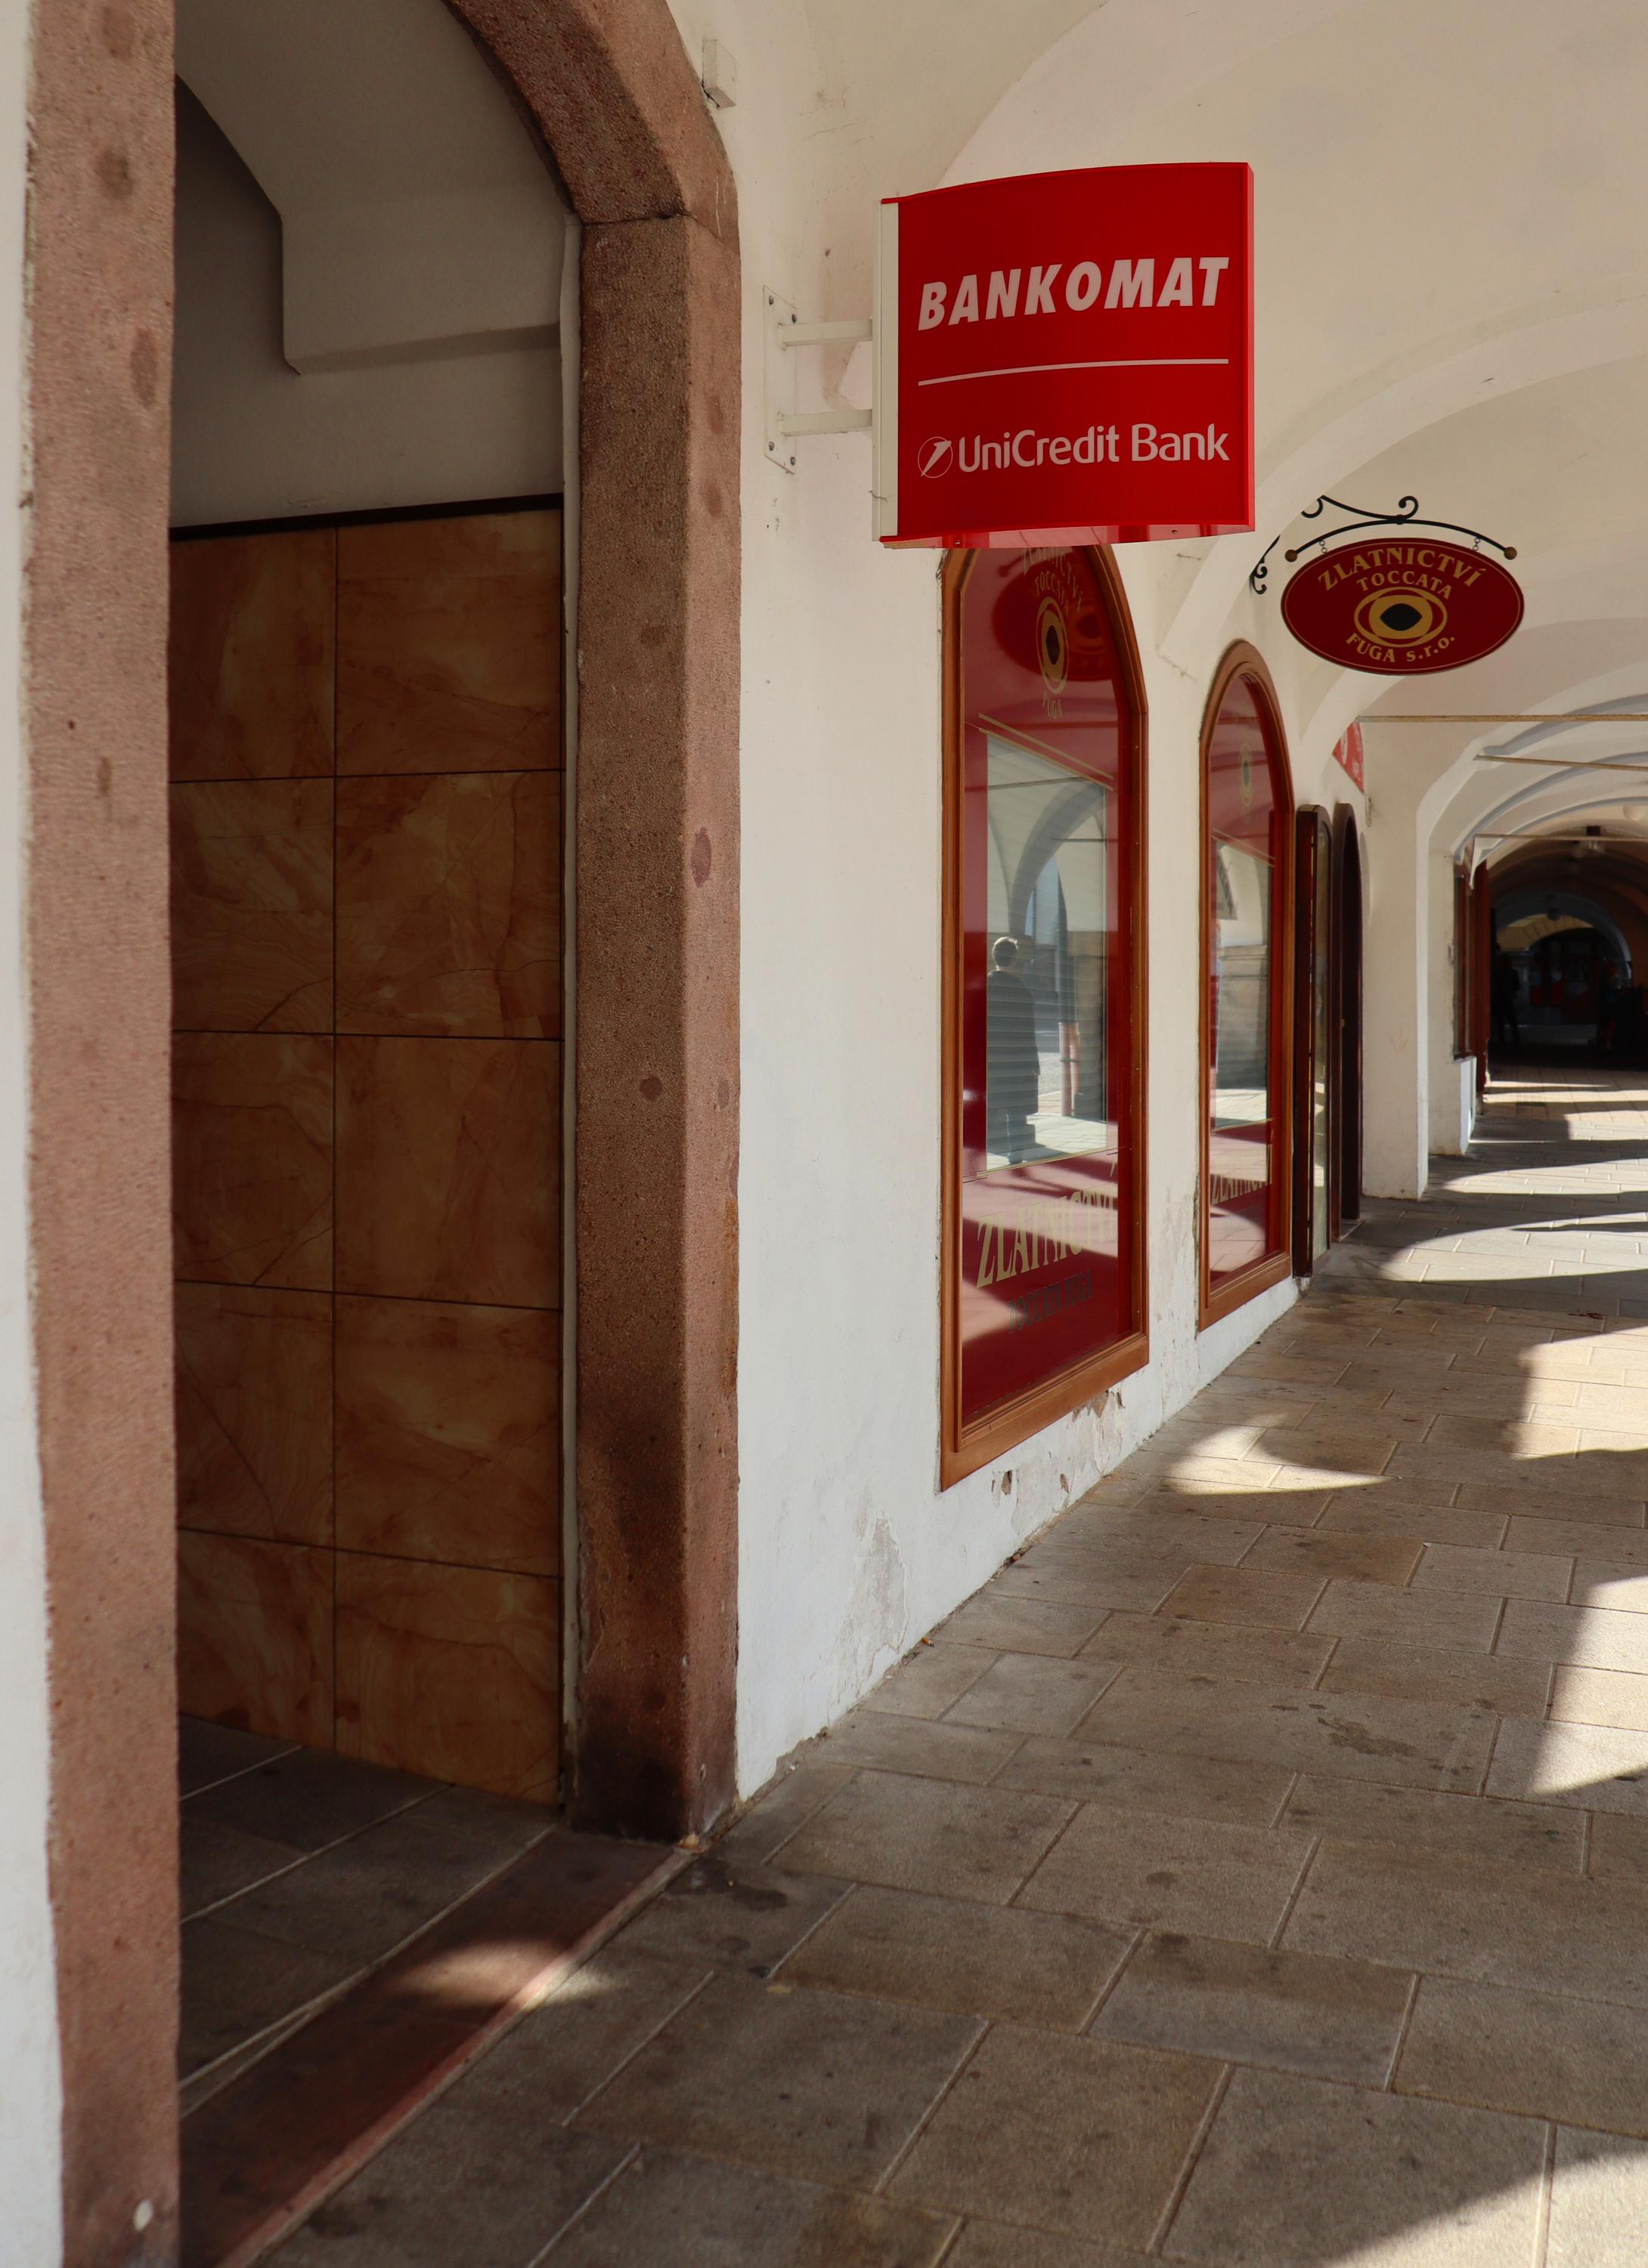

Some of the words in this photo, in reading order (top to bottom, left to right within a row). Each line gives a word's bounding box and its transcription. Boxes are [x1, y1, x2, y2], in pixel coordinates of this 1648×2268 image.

[918, 257, 1230, 331] BANKOMAT
[959, 425, 1120, 472] UniCredit
[1131, 423, 1230, 462] Bank
[1318, 547, 1487, 591] ZLATNICTVÍ
[1356, 571, 1452, 600] TOCCATA
[1346, 633, 1396, 662] FUGA
[1407, 636, 1455, 662] s.r.o.
